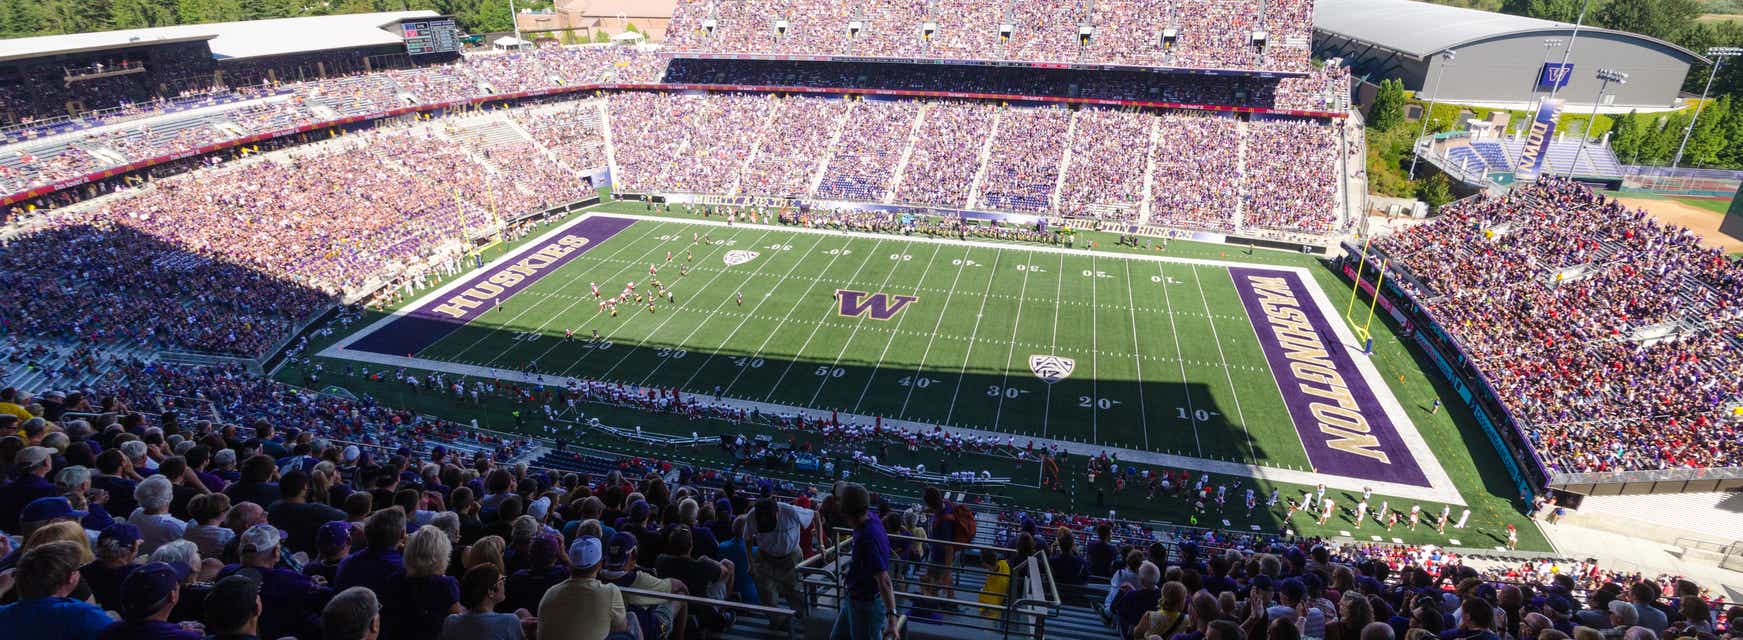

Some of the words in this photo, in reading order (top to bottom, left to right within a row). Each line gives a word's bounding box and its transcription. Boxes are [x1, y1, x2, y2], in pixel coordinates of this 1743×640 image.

[1548, 67, 1570, 82] W
[431, 234, 590, 319] HUSKIES
[837, 288, 920, 321] W
[657, 347, 688, 359] 30
[735, 357, 766, 369] 40
[1247, 275, 1392, 465] WASHINGTON
[815, 366, 846, 378] 50
[898, 375, 931, 388] 40
[986, 384, 1019, 399] 30
[1079, 395, 1111, 410] 20
[1175, 407, 1209, 422] 10
